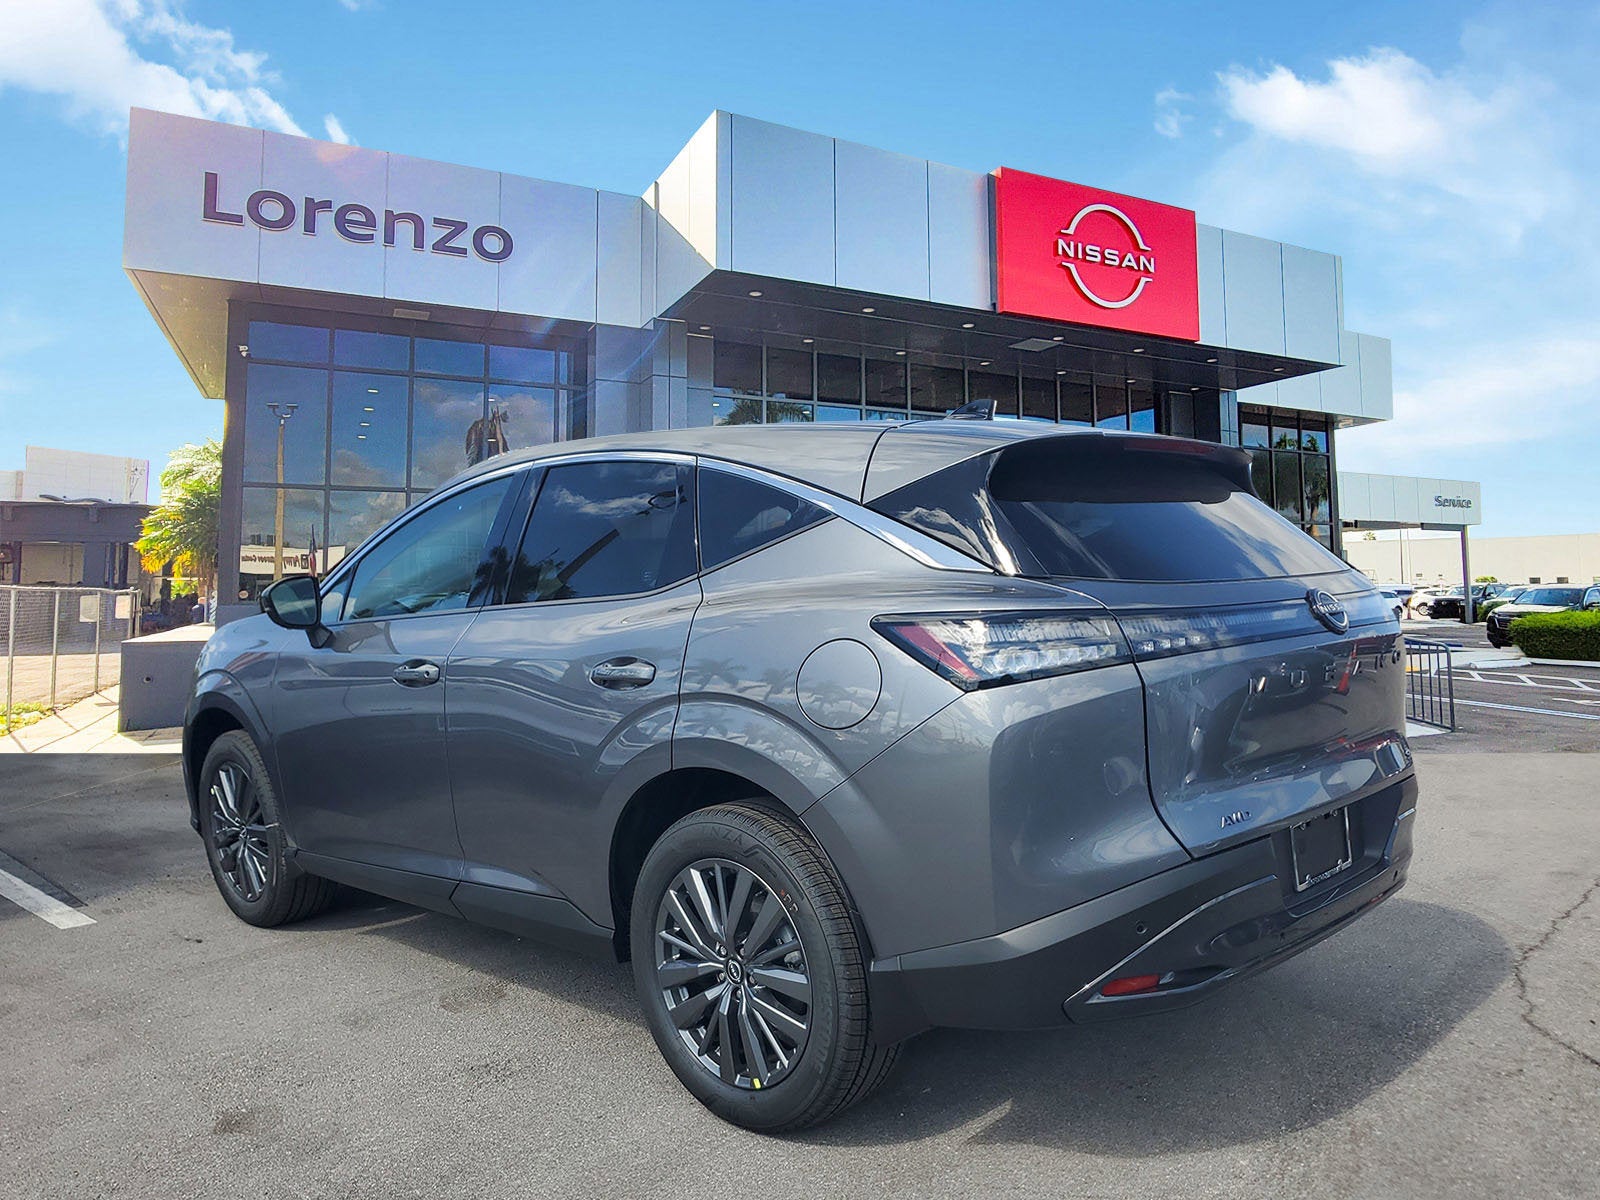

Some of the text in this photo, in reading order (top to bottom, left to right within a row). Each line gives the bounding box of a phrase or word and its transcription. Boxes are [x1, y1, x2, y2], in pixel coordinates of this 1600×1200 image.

[202, 171, 514, 262] Lorenzo
[1057, 238, 1155, 273] NISSAN
[1434, 495, 1472, 509] Service
